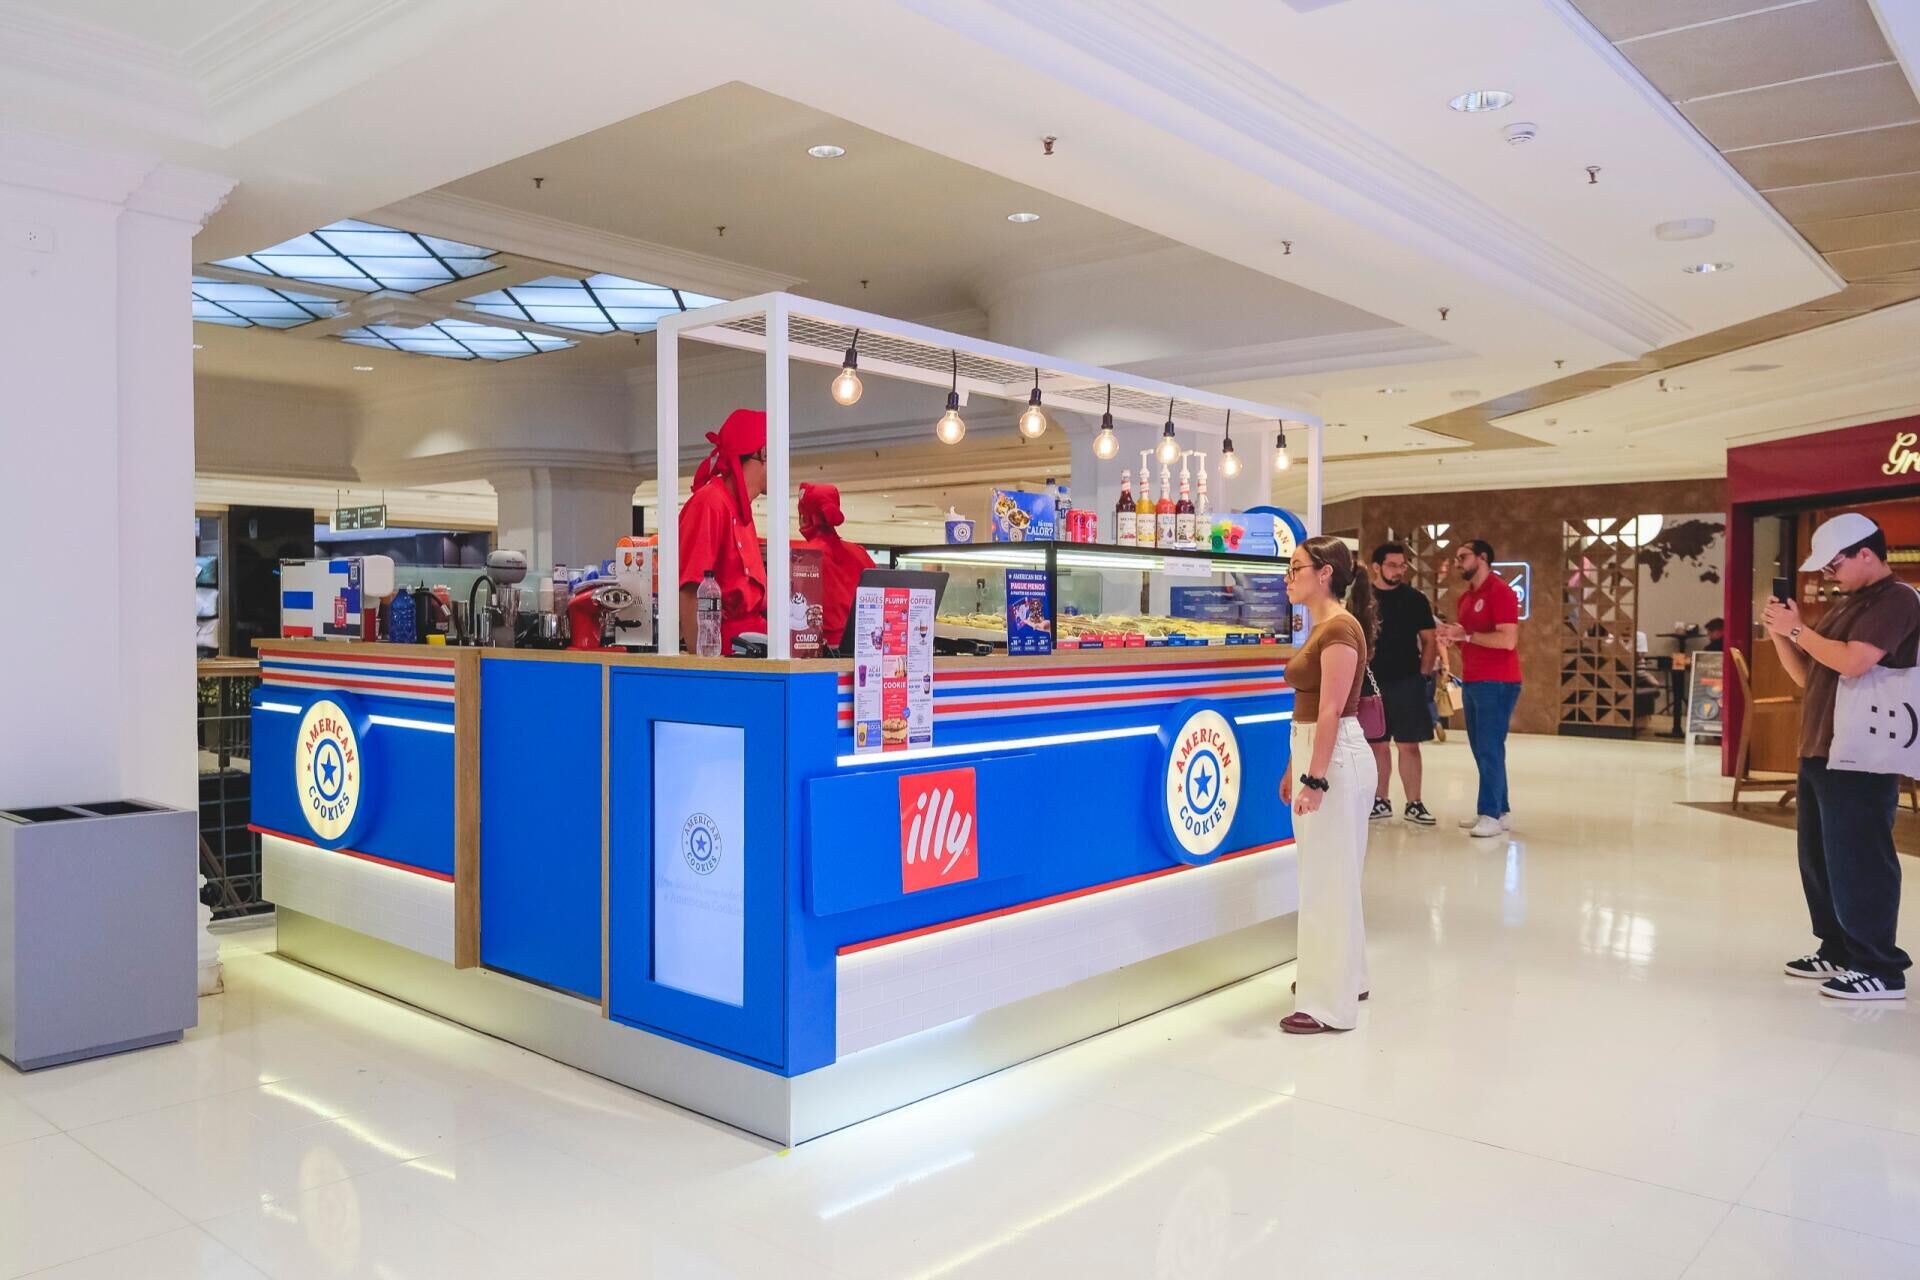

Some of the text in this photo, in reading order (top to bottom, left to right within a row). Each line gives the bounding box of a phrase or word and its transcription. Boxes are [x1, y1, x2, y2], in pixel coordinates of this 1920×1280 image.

[1026, 526, 1054, 537] CALOR?
[1028, 583, 1046, 591] MENOS
[859, 596, 883, 604] SHAKES
[884, 597, 908, 605] FLURRY
[910, 597, 933, 605] COFFEE
[795, 633, 818, 642] COMBO
[883, 681, 906, 689] COOKIE
[305, 717, 355, 764] AMERICAN
[1176, 727, 1232, 774] AMERICAN
[308, 785, 350, 821] COOKIES
[1179, 798, 1227, 836] COOKIES
[684, 815, 721, 841] AMERICAN
[906, 787, 972, 876] illy
[687, 852, 717, 872] COOKIES
